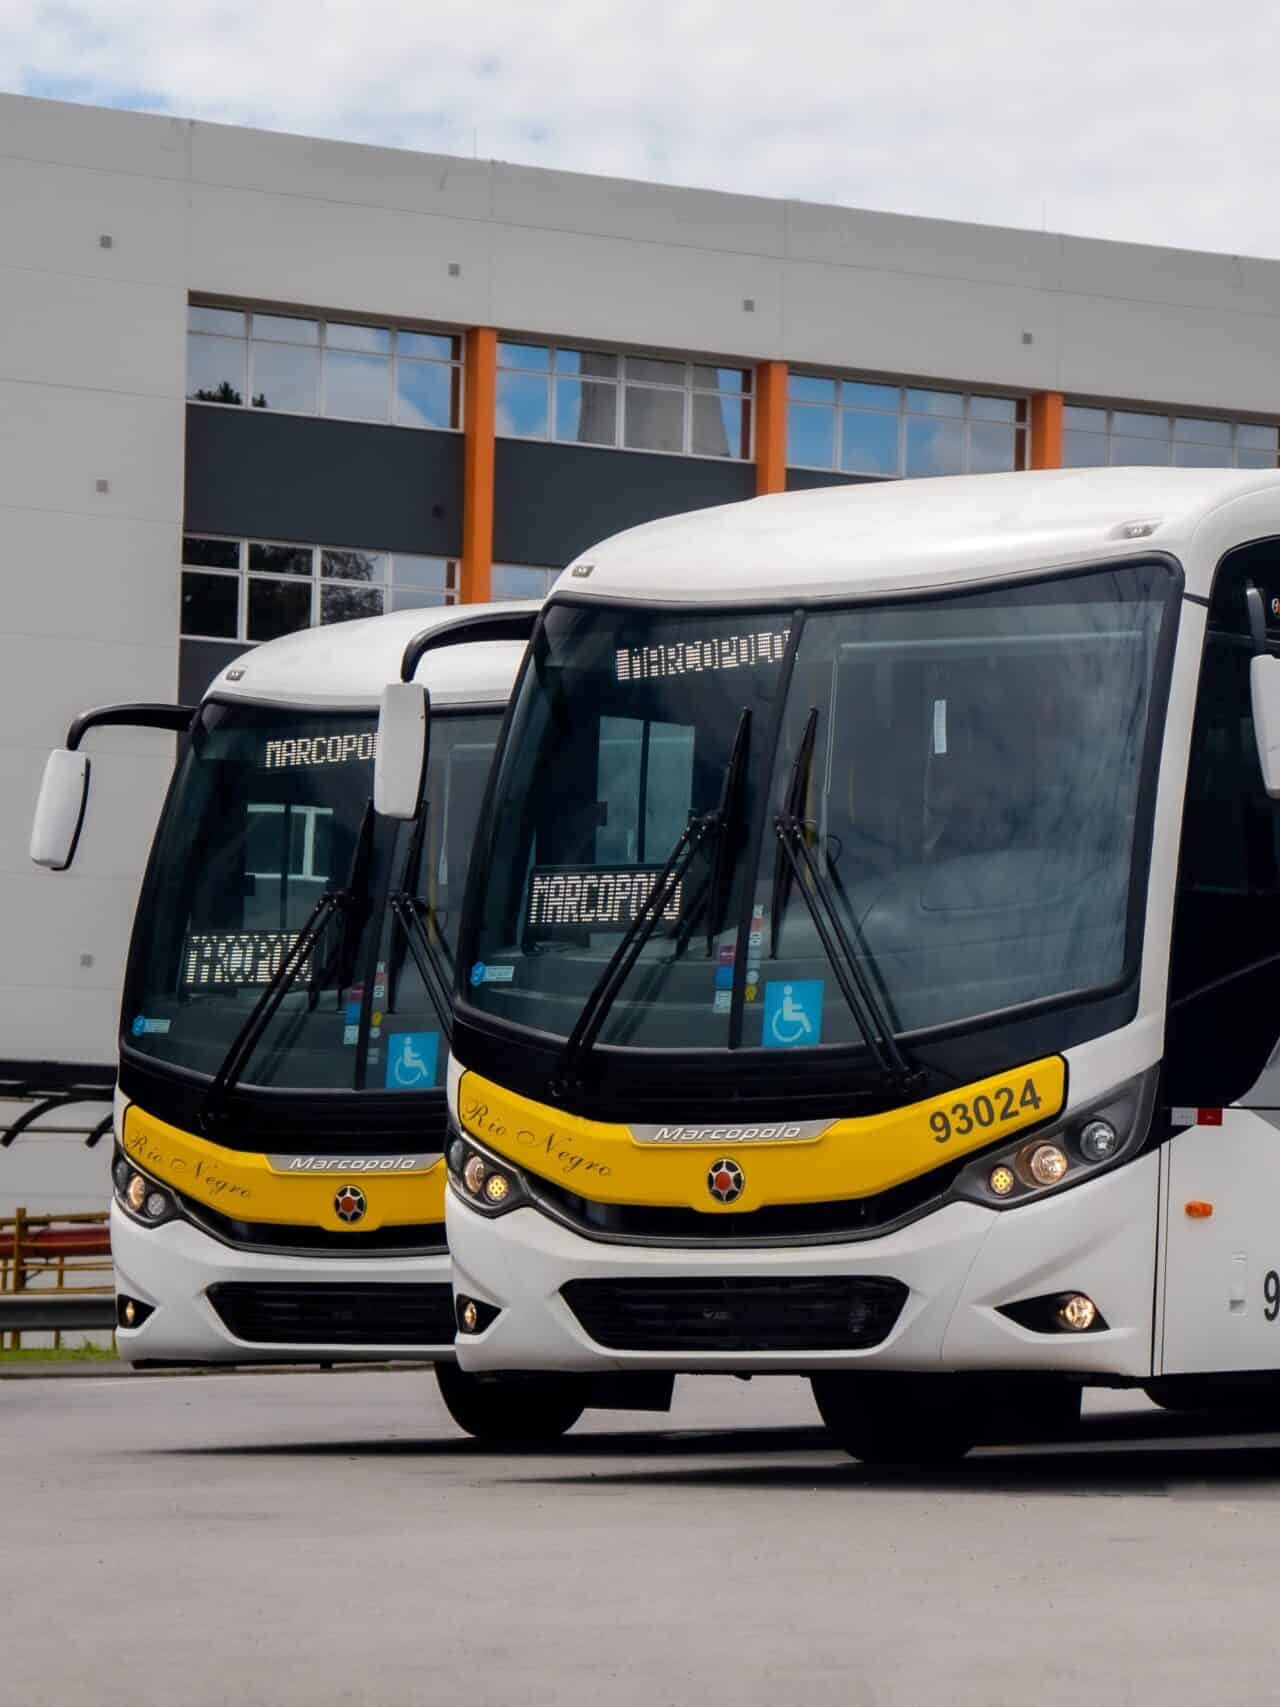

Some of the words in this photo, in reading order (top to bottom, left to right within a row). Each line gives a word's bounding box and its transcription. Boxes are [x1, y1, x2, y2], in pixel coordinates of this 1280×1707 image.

[265, 732, 380, 768] MARCOPO
[653, 1124, 801, 1142] Marcopolo
[928, 1077, 1042, 1144] 93024
[126, 1129, 163, 1162] Rio
[170, 1156, 252, 1199] Negro
[461, 1099, 507, 1137] Rio
[514, 1128, 614, 1178] Negro
[288, 1157, 417, 1172] Marcopolo
